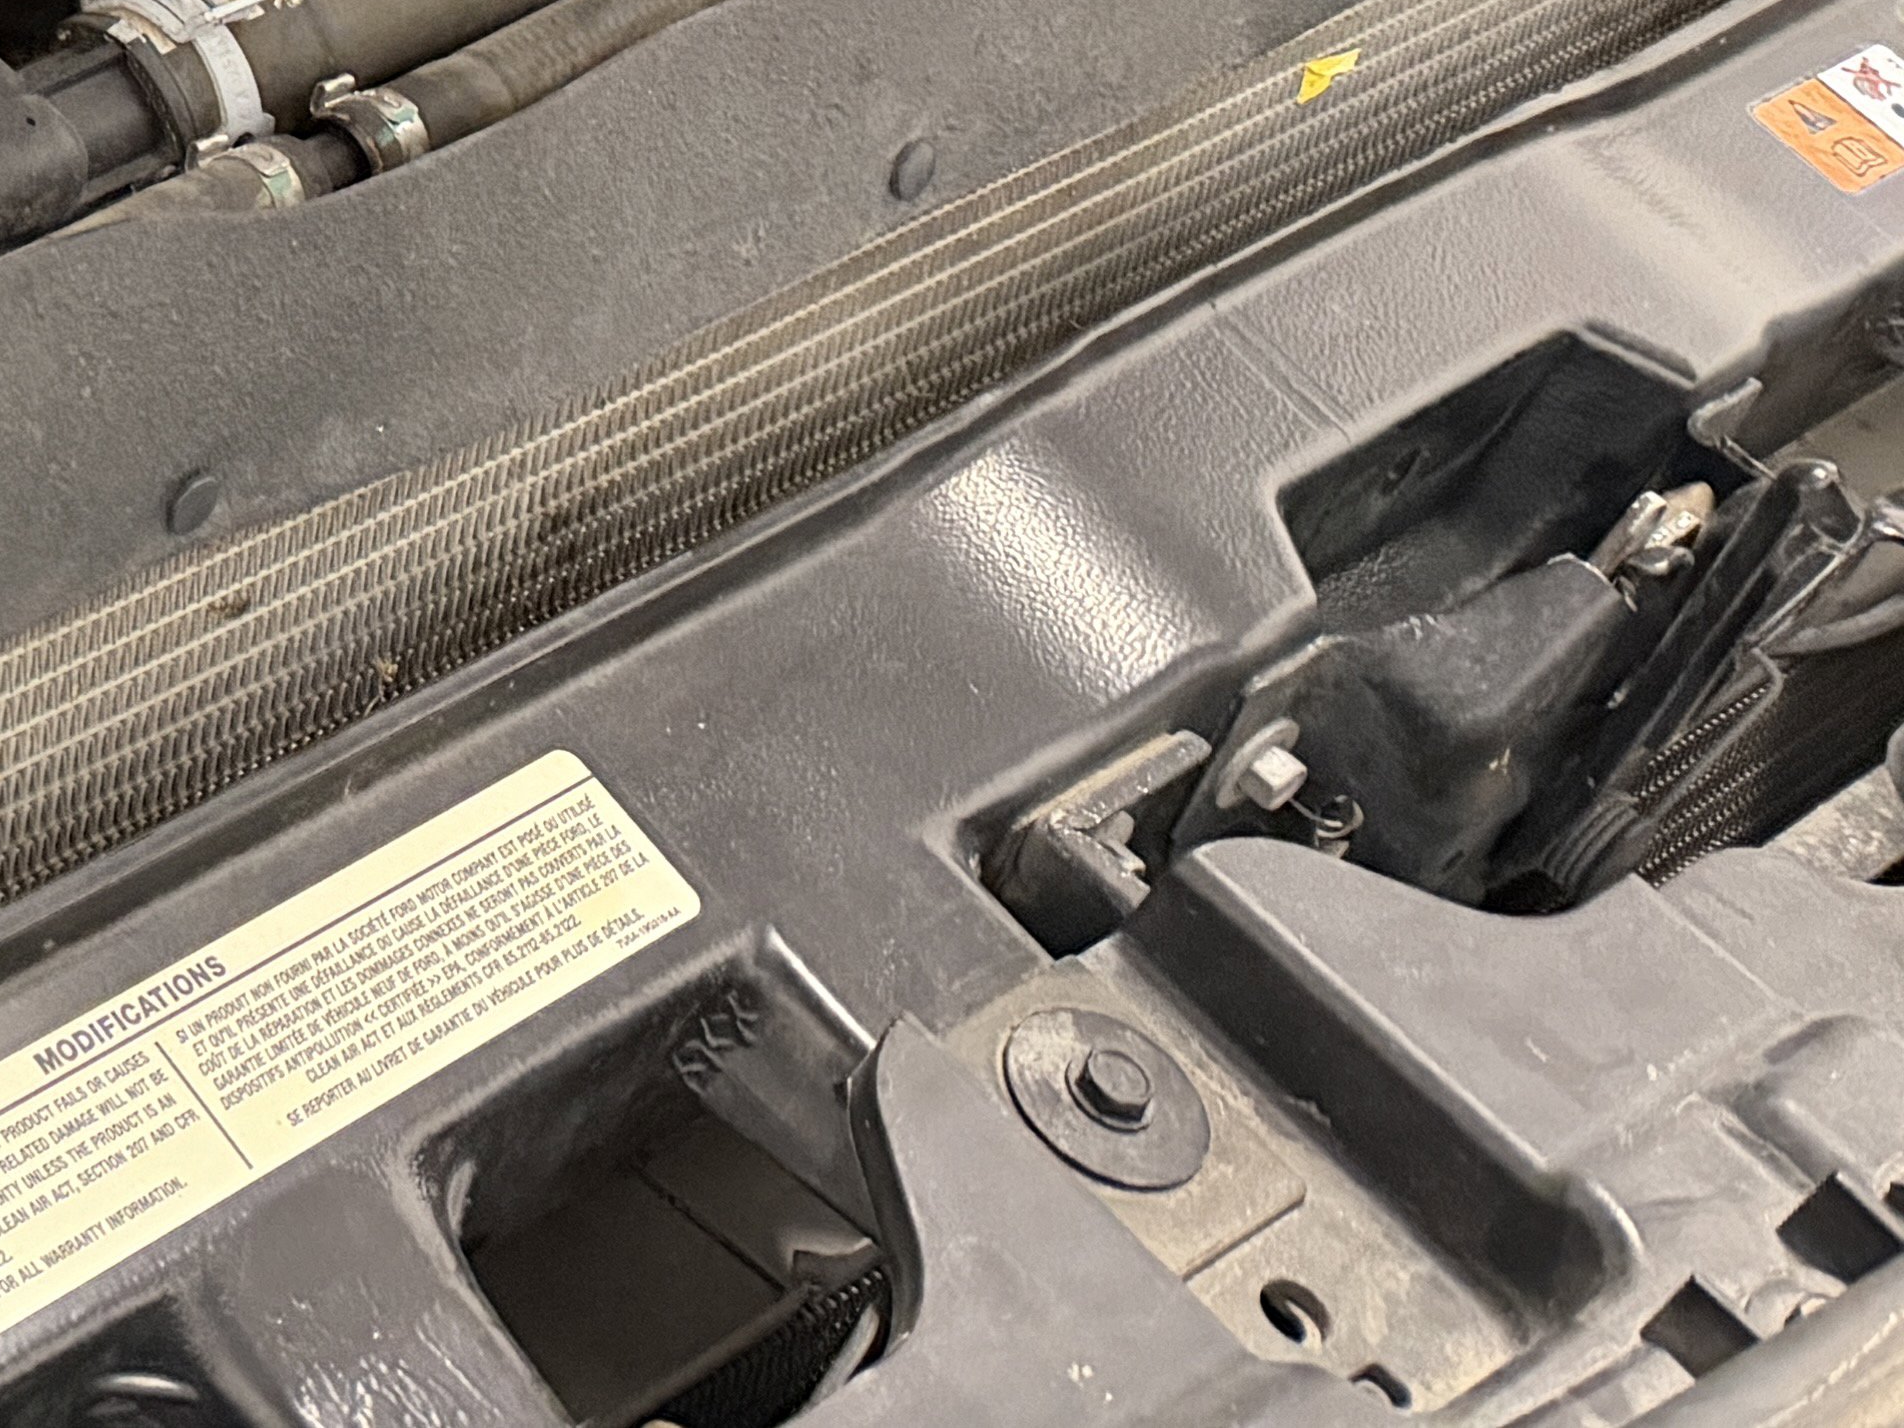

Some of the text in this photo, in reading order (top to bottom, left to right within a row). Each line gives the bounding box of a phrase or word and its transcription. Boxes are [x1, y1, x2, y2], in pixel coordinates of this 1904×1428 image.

[175, 1027, 189, 1044] SI
[187, 1017, 206, 1037] UN
[203, 992, 250, 1028] PRODUIT
[249, 978, 275, 1002] NON
[272, 956, 313, 988] FOURNI
[310, 944, 334, 966] PAR
[331, 935, 349, 954] LA
[387, 896, 418, 922] FORD
[415, 876, 453, 906] MOTOR
[449, 849, 499, 886] COMPANY
[496, 838, 518, 859] EST
[541, 815, 560, 833] OU
[33, 955, 227, 1075] MODIFICATIONS
[304, 1053, 342, 1083] CLEAN
[339, 1041, 361, 1063] AIR
[358, 1029, 382, 1051] ACT
[379, 1021, 396, 1039] ET
[394, 1007, 419, 1030] AUX
[480, 957, 504, 979] CFR
[47, 1108, 99, 1144] DAMAGE
[94, 1091, 127, 1117] WILL
[123, 1077, 151, 1100] NOT
[148, 1067, 169, 1086] BE
[52, 1085, 89, 1112] FAILS
[84, 1074, 107, 1094] OR
[102, 1049, 151, 1083] CAUSES
[19, 1154, 69, 1189] UNLESS
[65, 1140, 93, 1163] THE
[88, 1110, 145, 1149] PRODUCT
[141, 1102, 159, 1119] IS
[155, 1091, 177, 1111] AN
[26, 1193, 52, 1215] AIR
[48, 1177, 81, 1204] ACT,
[75, 1149, 128, 1186] SECTION
[124, 1136, 151, 1158] 207
[147, 1121, 177, 1144] AND
[172, 1107, 200, 1130] CFR
[15, 1259, 43, 1282] ALL
[39, 1220, 107, 1268] WARRANTY
[103, 1173, 187, 1230] INFORMATION.
